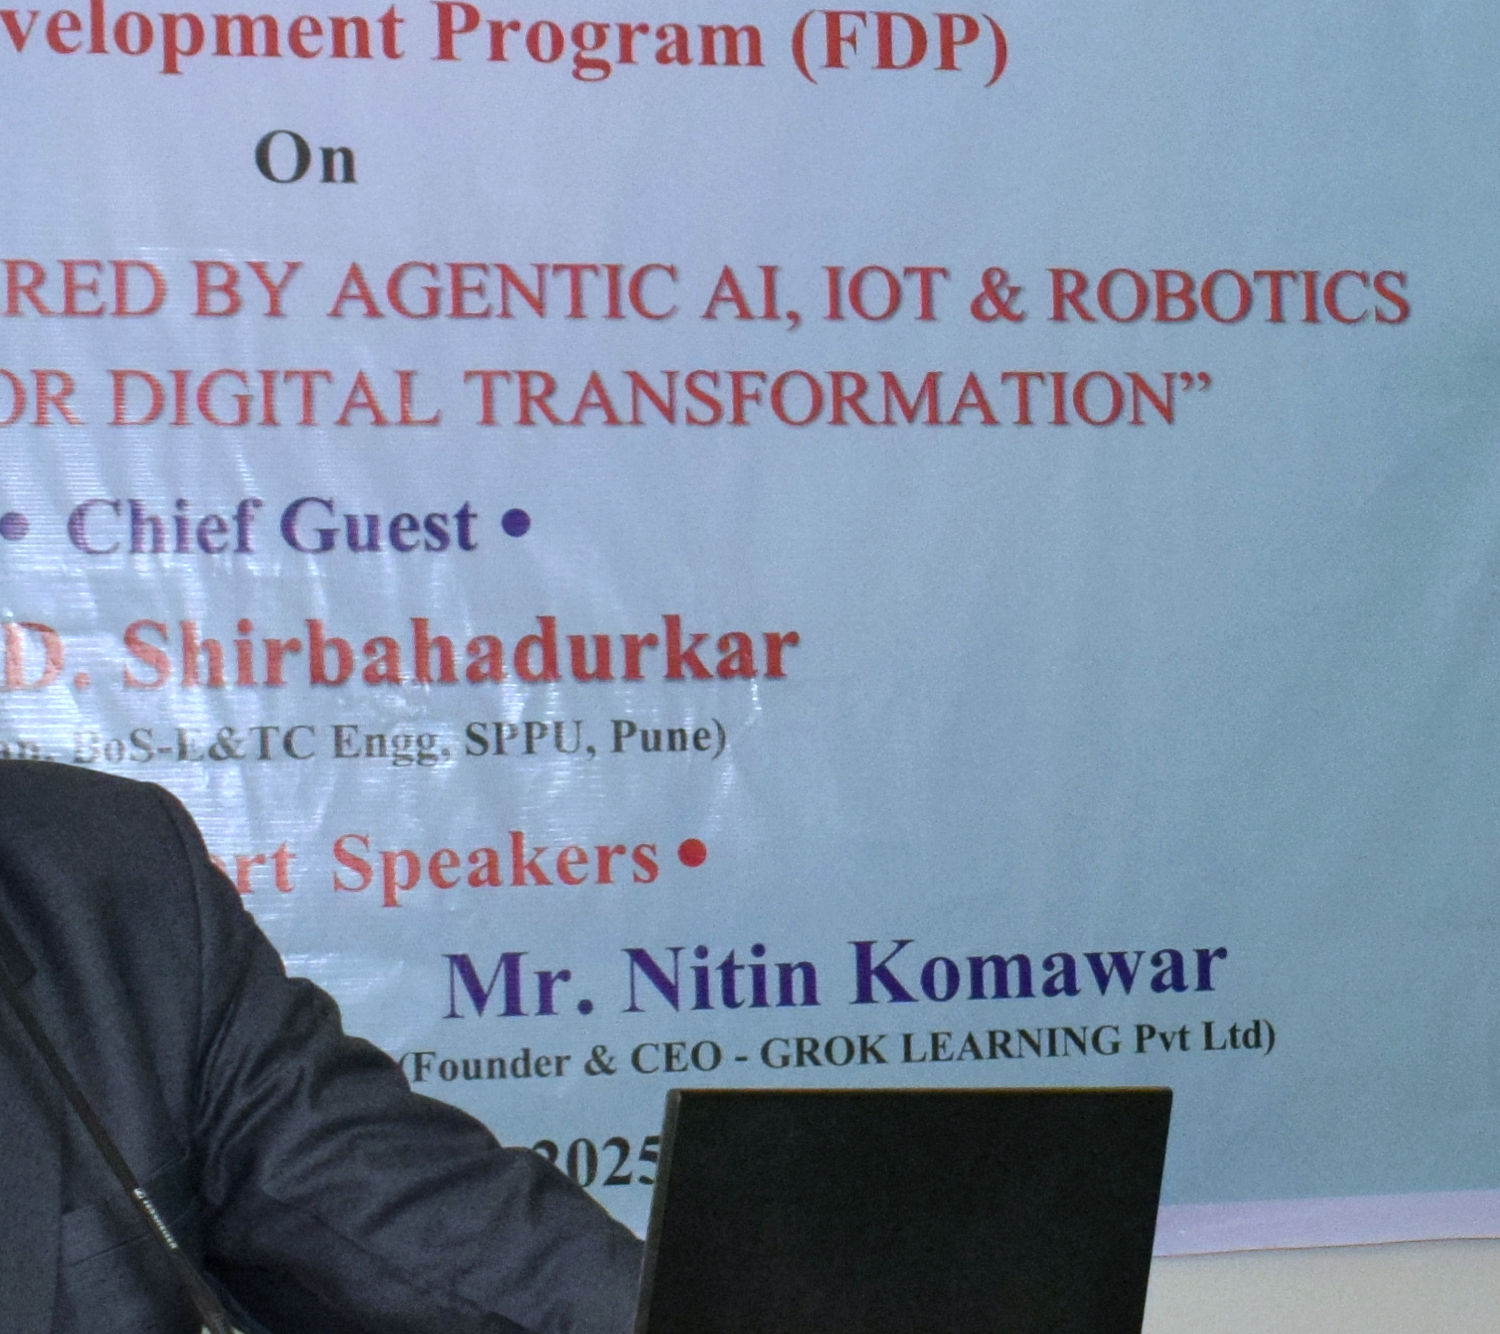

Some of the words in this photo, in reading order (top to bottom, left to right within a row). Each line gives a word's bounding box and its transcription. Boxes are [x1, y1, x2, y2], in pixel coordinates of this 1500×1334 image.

[430, 0, 765, 84] Program
[791, 9, 1010, 87] (FDP)
[252, 128, 359, 186] On
[195, 257, 300, 320] BY
[329, 262, 678, 321] AGENTIC
[702, 264, 803, 330] AI,
[823, 267, 948, 321] IOT
[969, 270, 1025, 325] &
[1049, 267, 1412, 327] ROBOTICS
[108, 367, 440, 430] DIGITAL
[464, 368, 1212, 428] TRANSFORMATION”
[67, 495, 257, 557] Chief
[282, 497, 479, 554] Guest
[122, 613, 800, 691] Shirbahadurkar
[330, 722, 452, 767] Engg,
[465, 718, 598, 762] SPPU,
[611, 717, 728, 758] Pune)
[212, 838, 296, 895] rt
[332, 829, 660, 908] Speakers
[444, 950, 596, 1021] Mr.
[622, 939, 821, 1015] Nitin
[849, 933, 1229, 1008] Komawar
[584, 1045, 616, 1078] &
[631, 1039, 720, 1072] CEO
[762, 1032, 891, 1070] GROK
[902, 1024, 1122, 1065] LEARNING
[1134, 1021, 1194, 1056] Pvt
[1202, 1018, 1275, 1059] Ltd)
